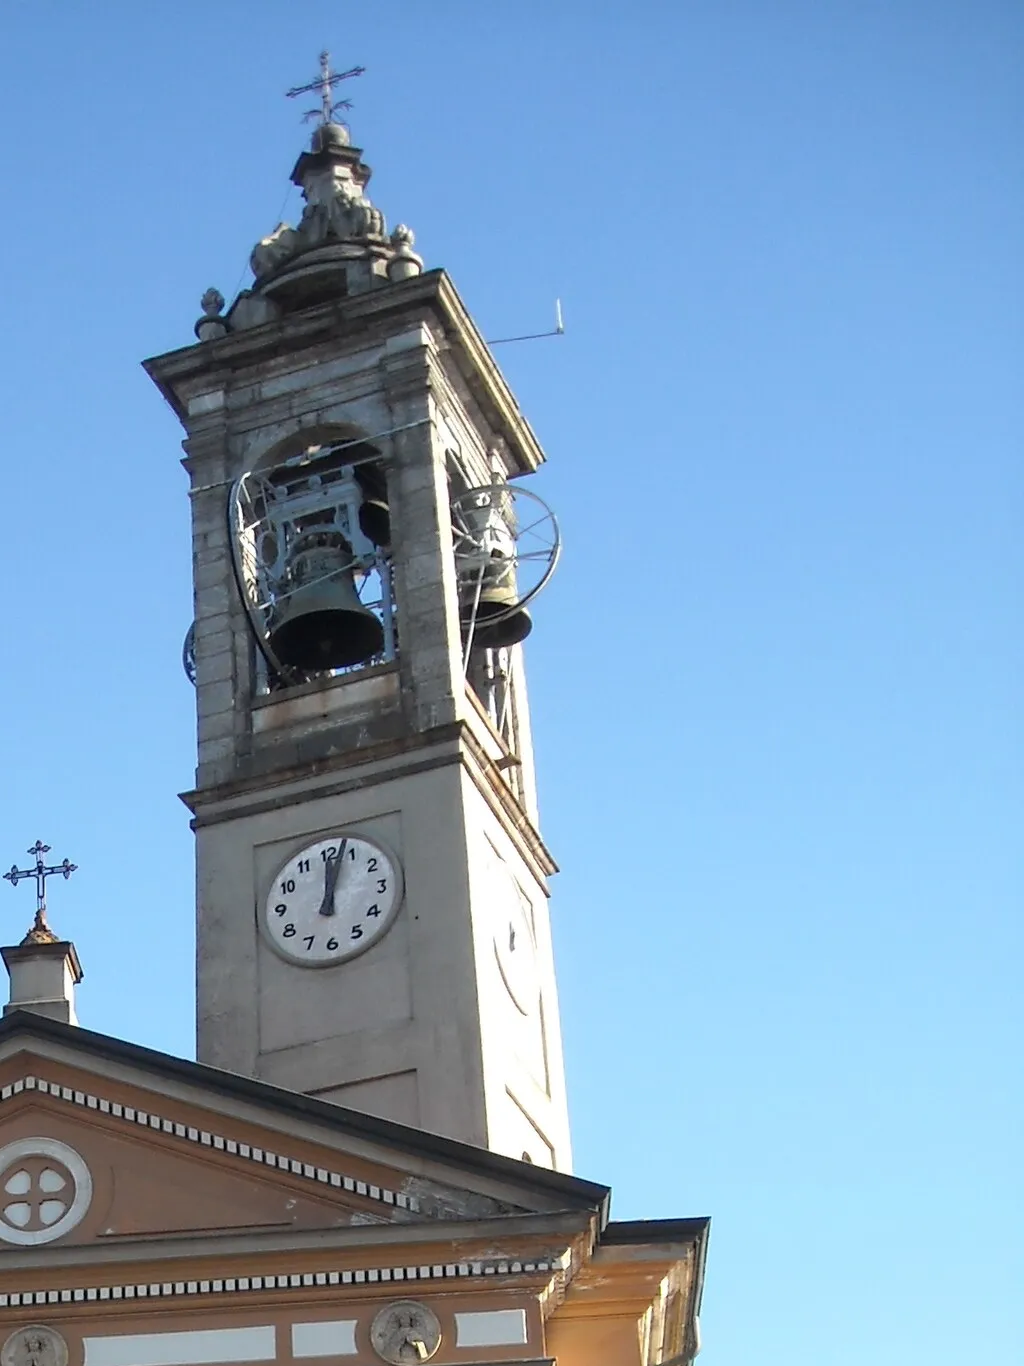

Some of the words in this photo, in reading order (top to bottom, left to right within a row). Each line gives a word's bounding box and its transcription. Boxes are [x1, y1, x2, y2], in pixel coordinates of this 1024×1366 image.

[321, 847, 338, 862] 12
[349, 848, 355, 860] 1
[298, 860, 310, 873] 11
[367, 859, 377, 872] 2
[281, 880, 295, 894] 10
[377, 879, 386, 893] 3
[275, 904, 287, 917] 9
[367, 904, 381, 917] 4
[283, 924, 296, 937] 8
[351, 925, 363, 939] 5
[304, 936, 315, 950] 7
[327, 938, 338, 950] 6
